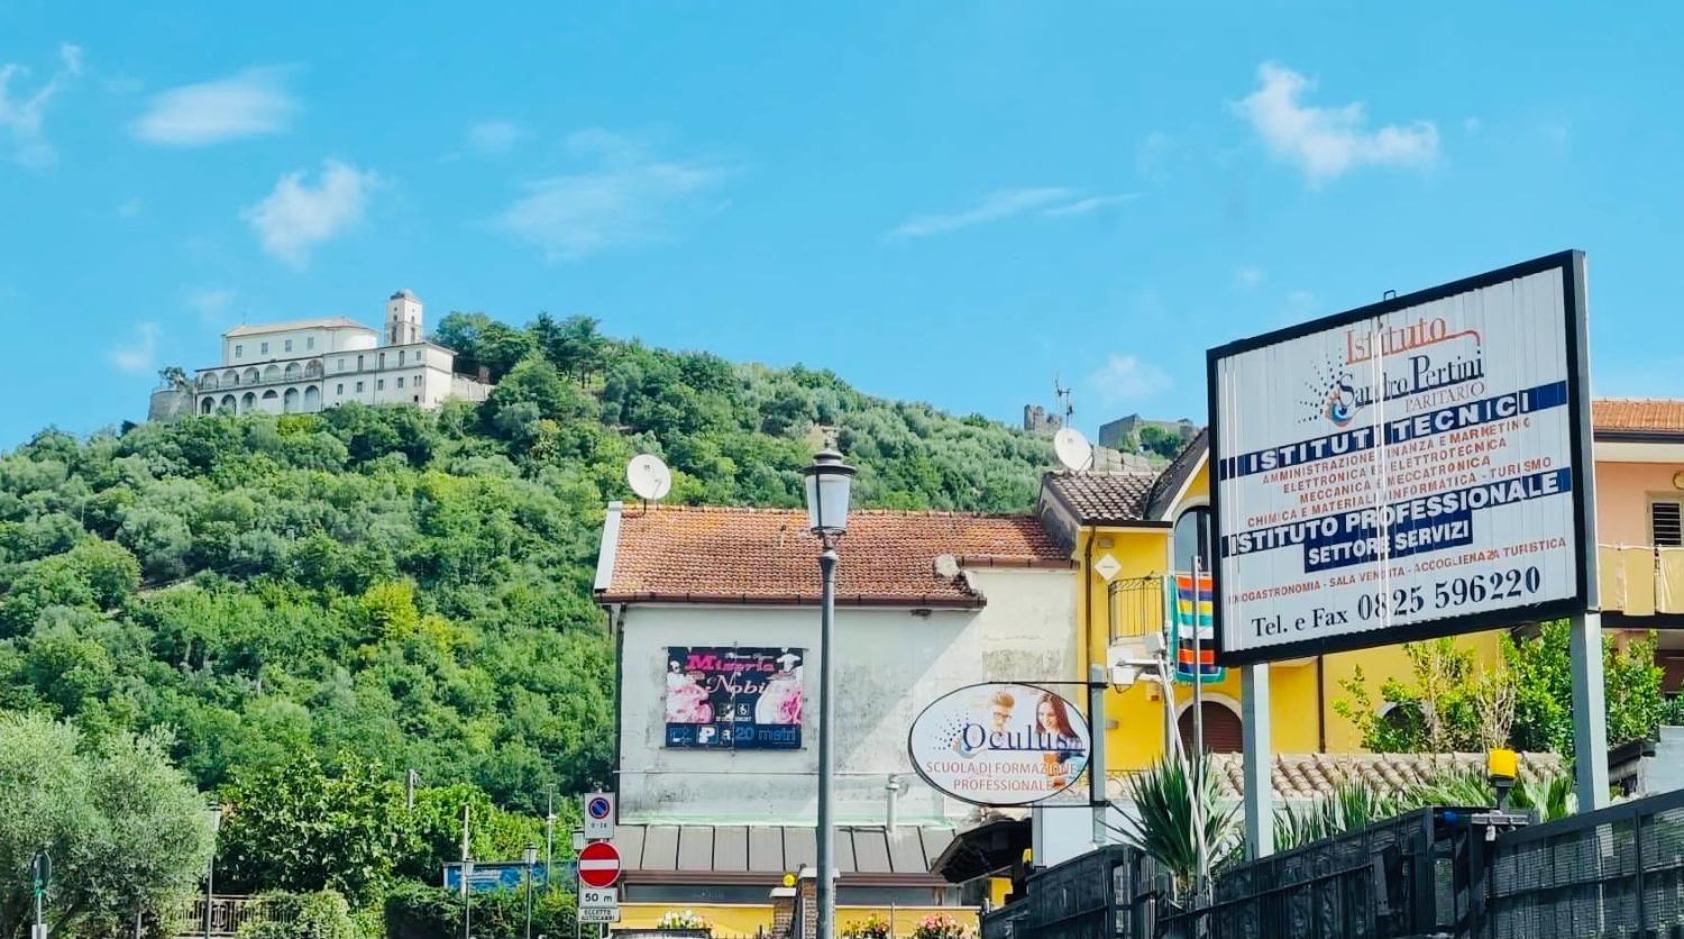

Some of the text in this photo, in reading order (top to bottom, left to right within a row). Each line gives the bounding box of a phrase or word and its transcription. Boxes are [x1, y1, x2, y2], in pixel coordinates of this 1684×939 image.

[1345, 318, 1447, 365] Istituto
[1339, 350, 1484, 407] Sandro Pertini
[1406, 381, 1484, 412] PARITARIO
[1393, 393, 1529, 441] TECNICI
[1263, 451, 1375, 485] AMMINISTRAZIONE
[1382, 441, 1434, 459] INANZA
[1440, 436, 1446, 447] E
[1284, 466, 1366, 494] ELETTRONICA
[1391, 438, 1507, 471] ELETTROTECNICA
[1300, 480, 1371, 505] MECCANICA
[1387, 455, 1491, 486] MECCATRONICA
[1230, 472, 1558, 556] ISTITUTO PROFESSIONALE
[1248, 510, 1297, 527] CHIMICA
[1301, 507, 1307, 517] E
[1389, 473, 1476, 500] INFORMATICA
[1490, 456, 1552, 479] TURISMO
[1308, 520, 1469, 565] SETTORE SERVIZI
[1251, 566, 1541, 637] Tel. e Fax 0825 596220
[1329, 575, 1355, 588] SALA
[963, 722, 1068, 751] Oculus
[926, 761, 1077, 775] SCUOLA DI FORMAZIONE
[953, 779, 1053, 792] PROFESSIONALE
[585, 893, 598, 902] 50
